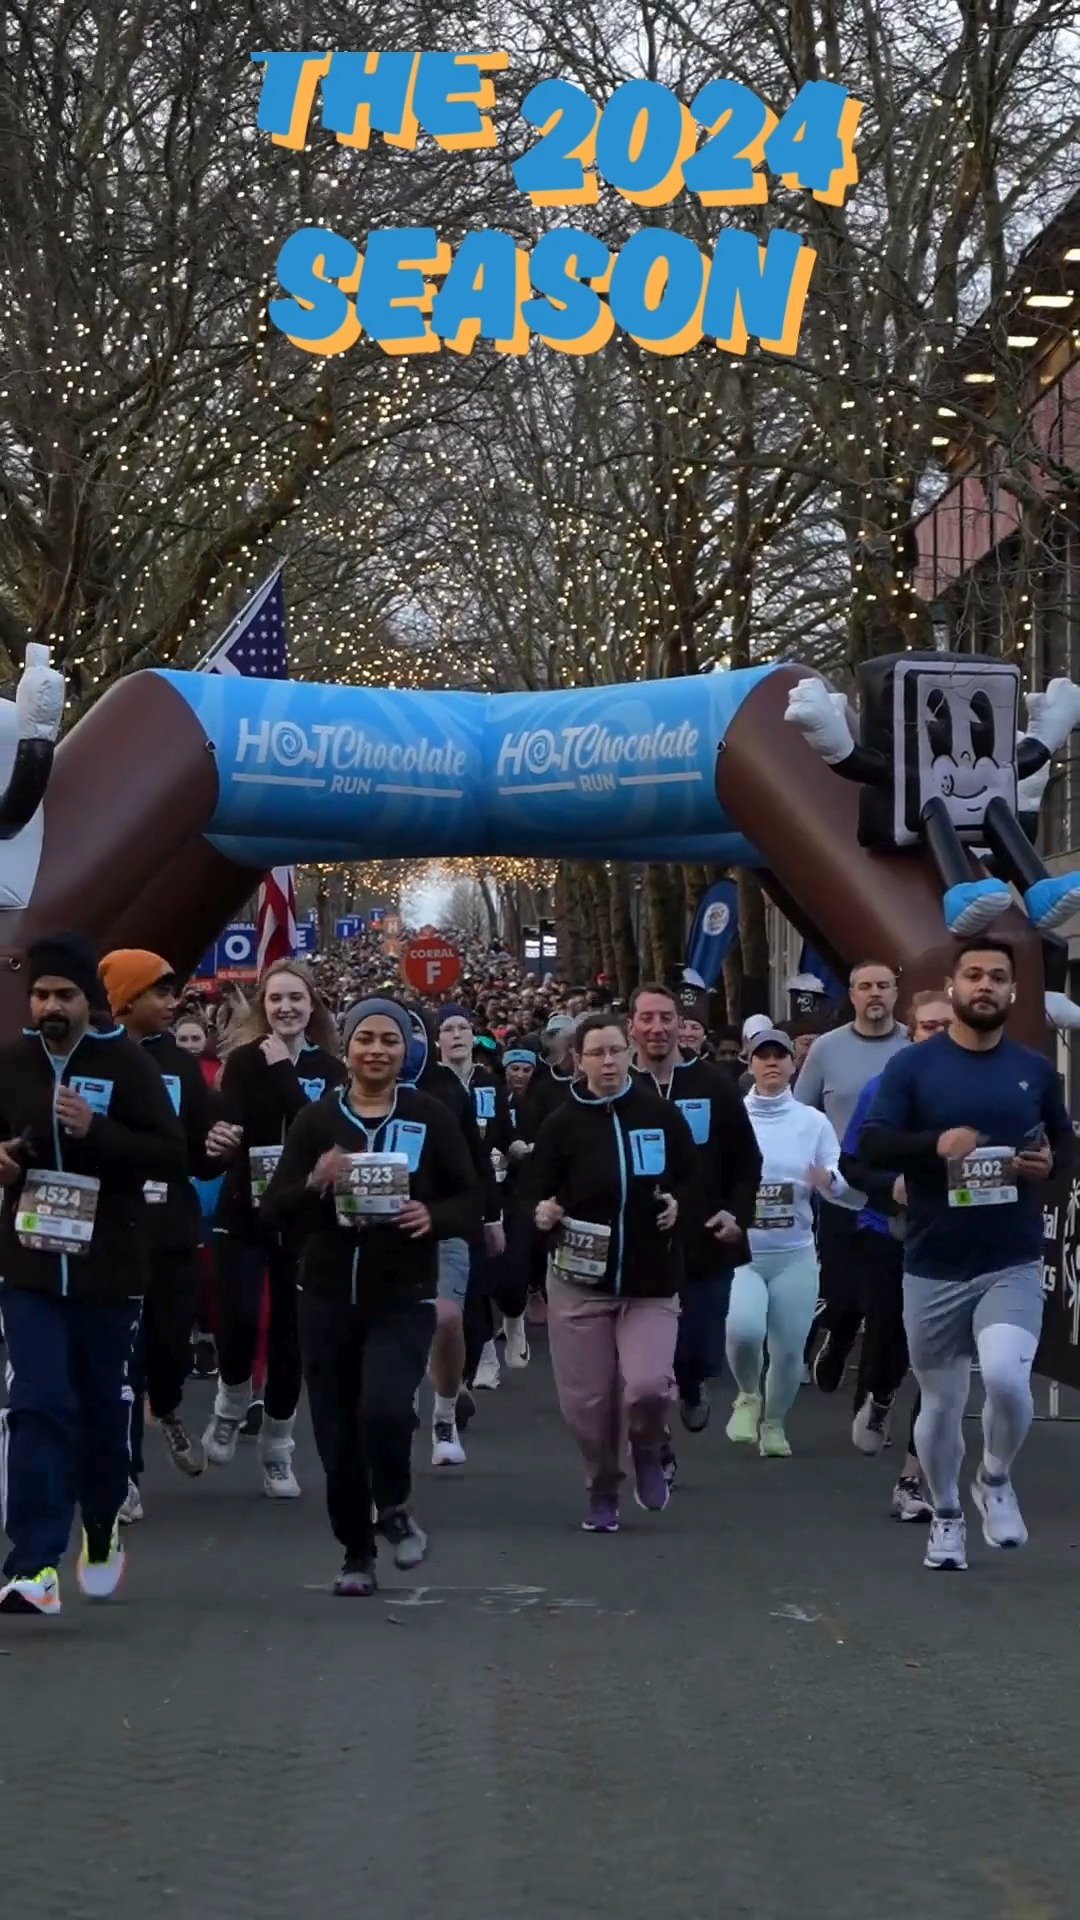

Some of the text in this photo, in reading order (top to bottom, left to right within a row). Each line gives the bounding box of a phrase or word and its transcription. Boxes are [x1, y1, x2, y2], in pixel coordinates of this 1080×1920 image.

[235, 718, 466, 777] HOT Chocolate
[496, 719, 699, 776] HOT Chocolate
[330, 774, 372, 795] RUN
[579, 773, 617, 793] RUN
[224, 934, 251, 961] O
[410, 948, 456, 959] CORRAL
[426, 960, 442, 985] F
[349, 1166, 394, 1184] 4523
[962, 1160, 1003, 1178] 1402
[35, 1184, 81, 1208] 4524
